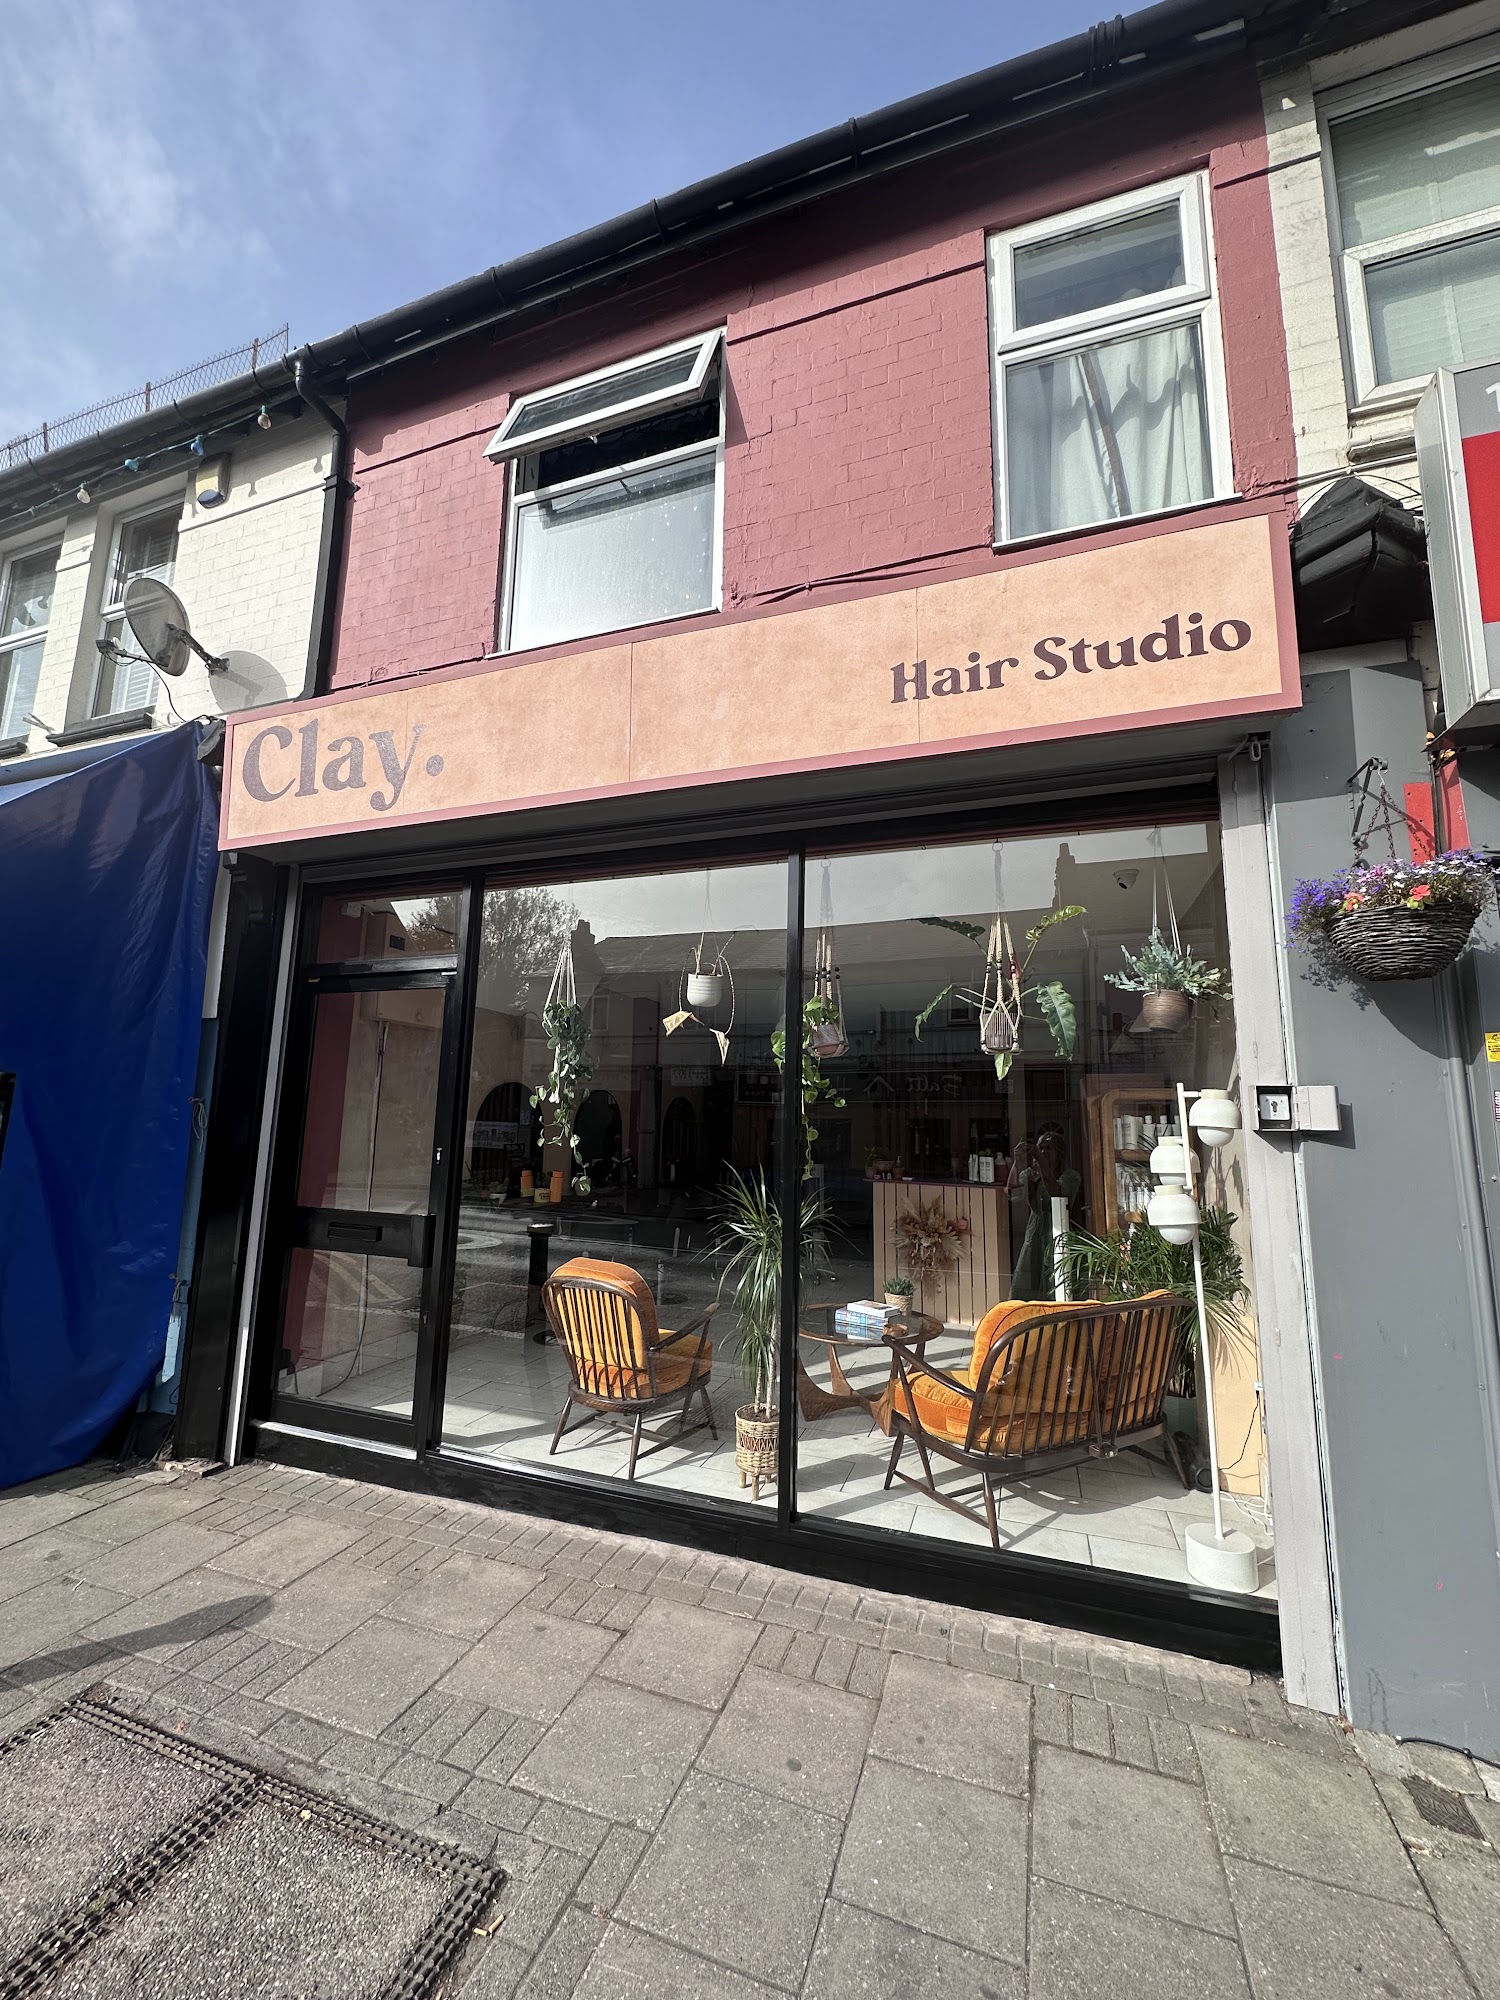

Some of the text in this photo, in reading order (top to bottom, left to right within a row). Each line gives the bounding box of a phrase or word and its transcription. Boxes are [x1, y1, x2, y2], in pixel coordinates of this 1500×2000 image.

[890, 612, 1252, 703] Hair Studio
[242, 718, 444, 812] Clay.
